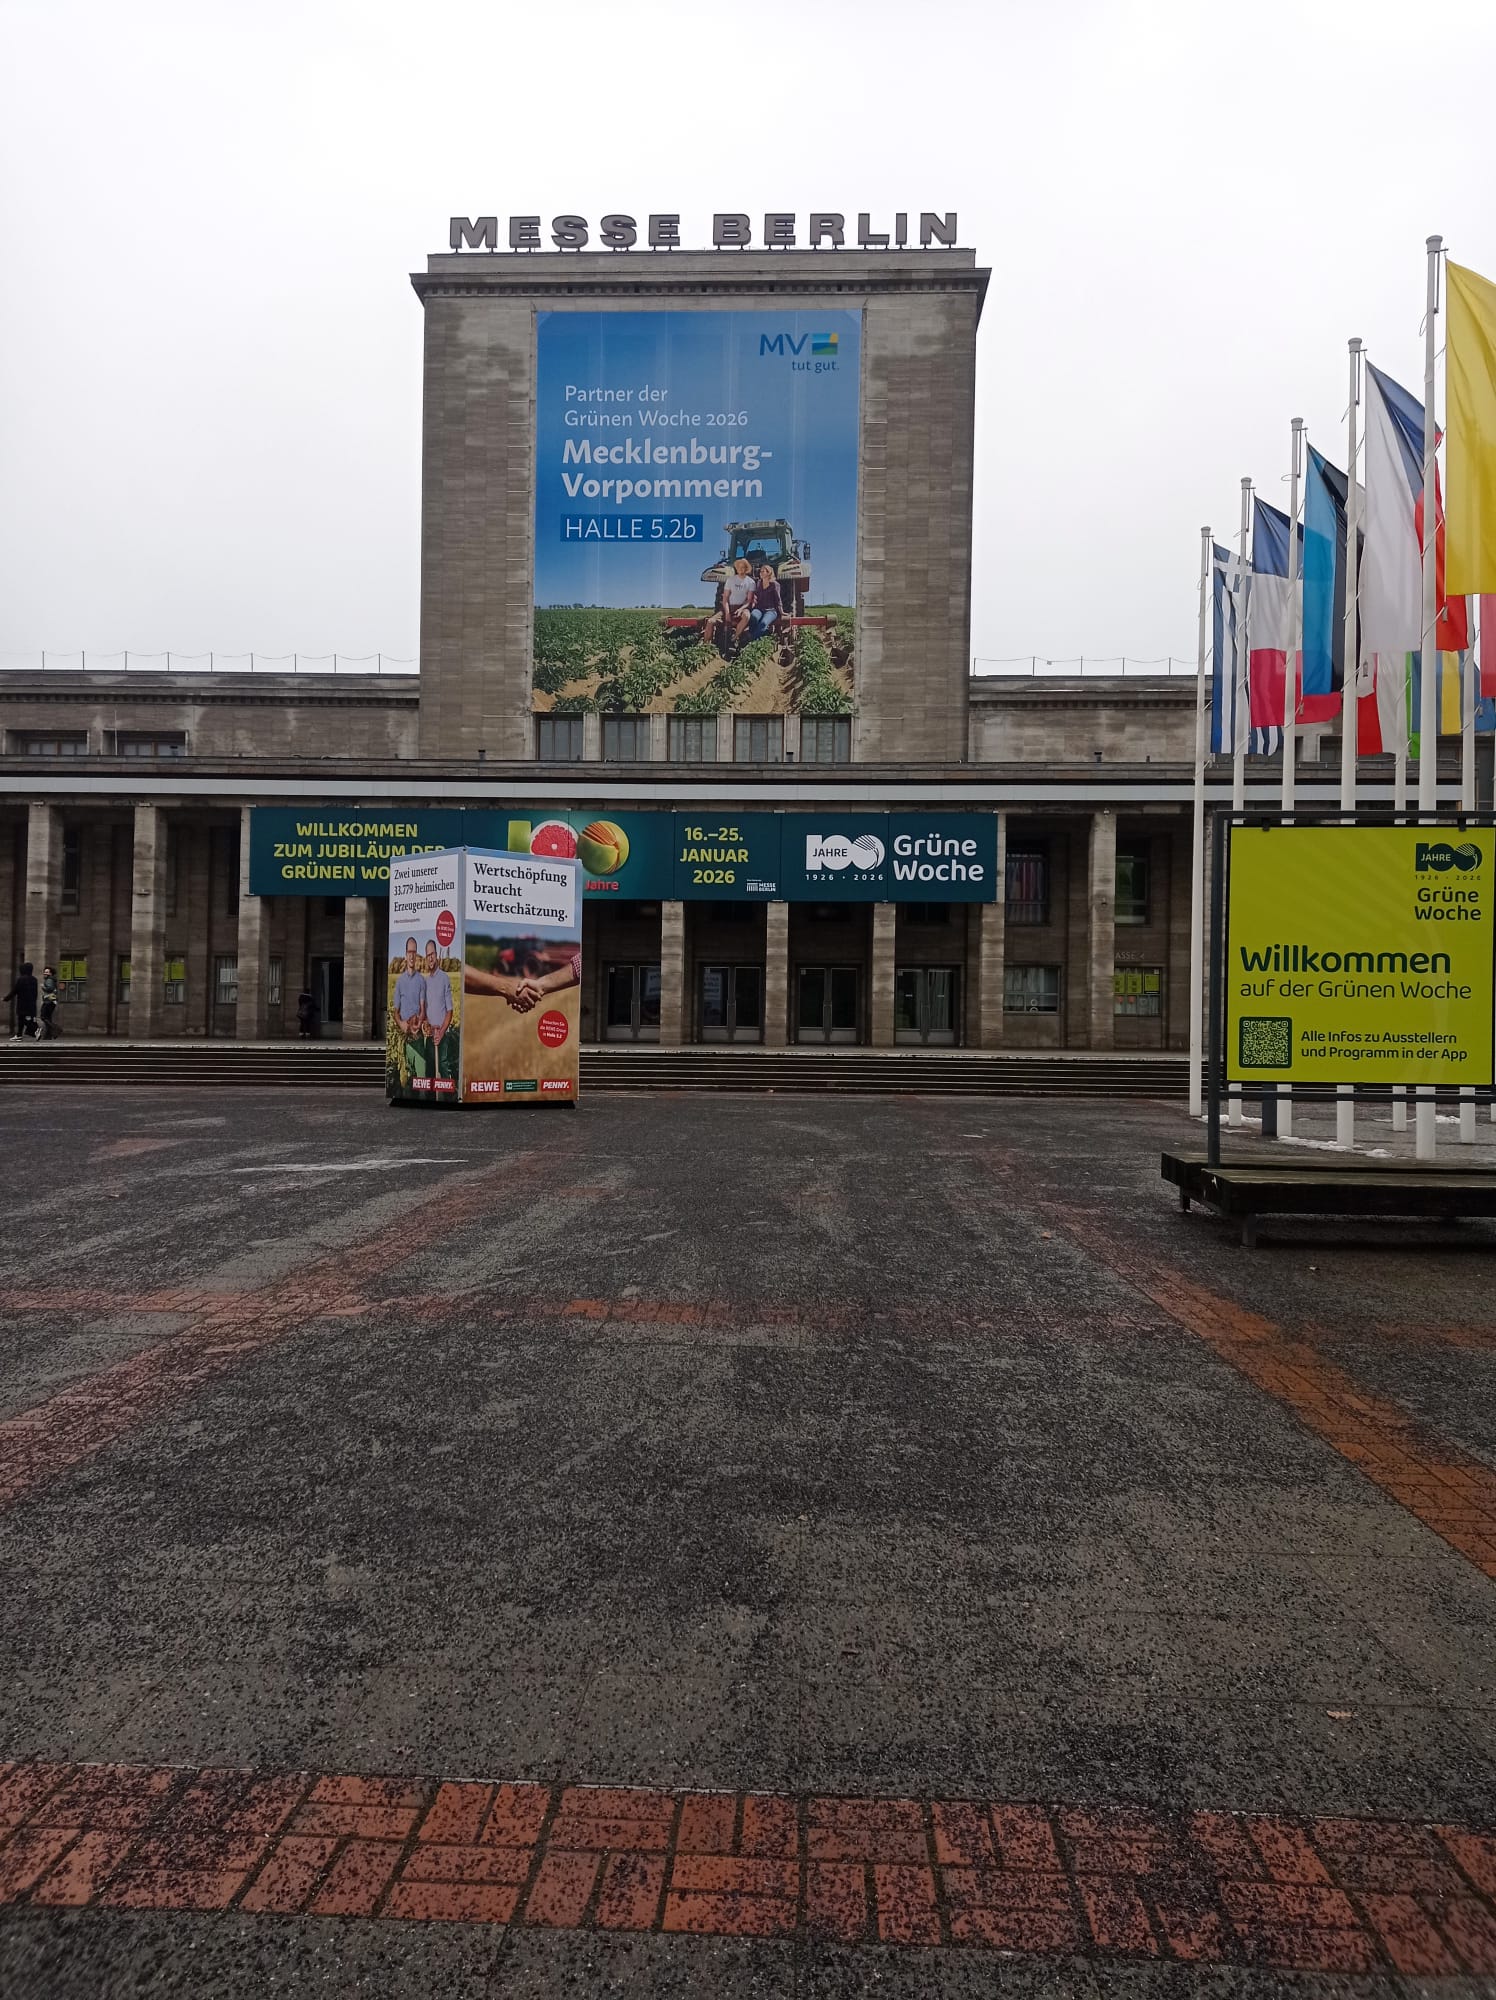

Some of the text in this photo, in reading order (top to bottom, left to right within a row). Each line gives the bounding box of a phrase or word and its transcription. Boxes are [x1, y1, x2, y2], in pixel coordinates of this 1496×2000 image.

[450, 212, 958, 249] MESSE BERLIN
[760, 333, 809, 356] MV
[792, 361, 840, 373] tut gut.
[565, 385, 668, 401] Partner der
[564, 409, 748, 426] Grünen Woche 2026
[562, 437, 773, 471] Mecklenburg-
[561, 472, 763, 504] Vorpommern
[565, 518, 696, 538] HALLE 5.2b
[296, 822, 418, 838] WILLKOMMEN
[273, 843, 312, 858] ZUM
[317, 841, 406, 858] JUBILÄUM
[812, 848, 848, 857] JAHRE
[893, 833, 977, 856] Grüne
[680, 848, 749, 863] JANUAR
[1421, 853, 1452, 862] JAHRE
[281, 861, 356, 880] GRÜNEN
[394, 866, 438, 880] Zwei unserer
[473, 862, 568, 887] Wertschöpfung
[693, 870, 735, 884] 2026
[805, 873, 884, 881] 1926 2026
[893, 859, 985, 882] Woche
[393, 879, 455, 896] 33.779 heimischen
[473, 880, 522, 897] braucht
[585, 879, 619, 891] Jahre
[1417, 886, 1479, 903] Grüne
[393, 898, 448, 914] Erzeuger:innen.
[473, 899, 568, 922] Wertschätzung.
[1414, 904, 1482, 921] Woche
[1239, 943, 1451, 974] Willkommen
[1239, 979, 1472, 999] auf der Grünen Woche
[1301, 1030, 1457, 1044] Alle Infos zu Ausstellern
[1301, 1046, 1468, 1061] und Programm in der App
[413, 1079, 431, 1089] REWE
[470, 1081, 500, 1092] REWE
